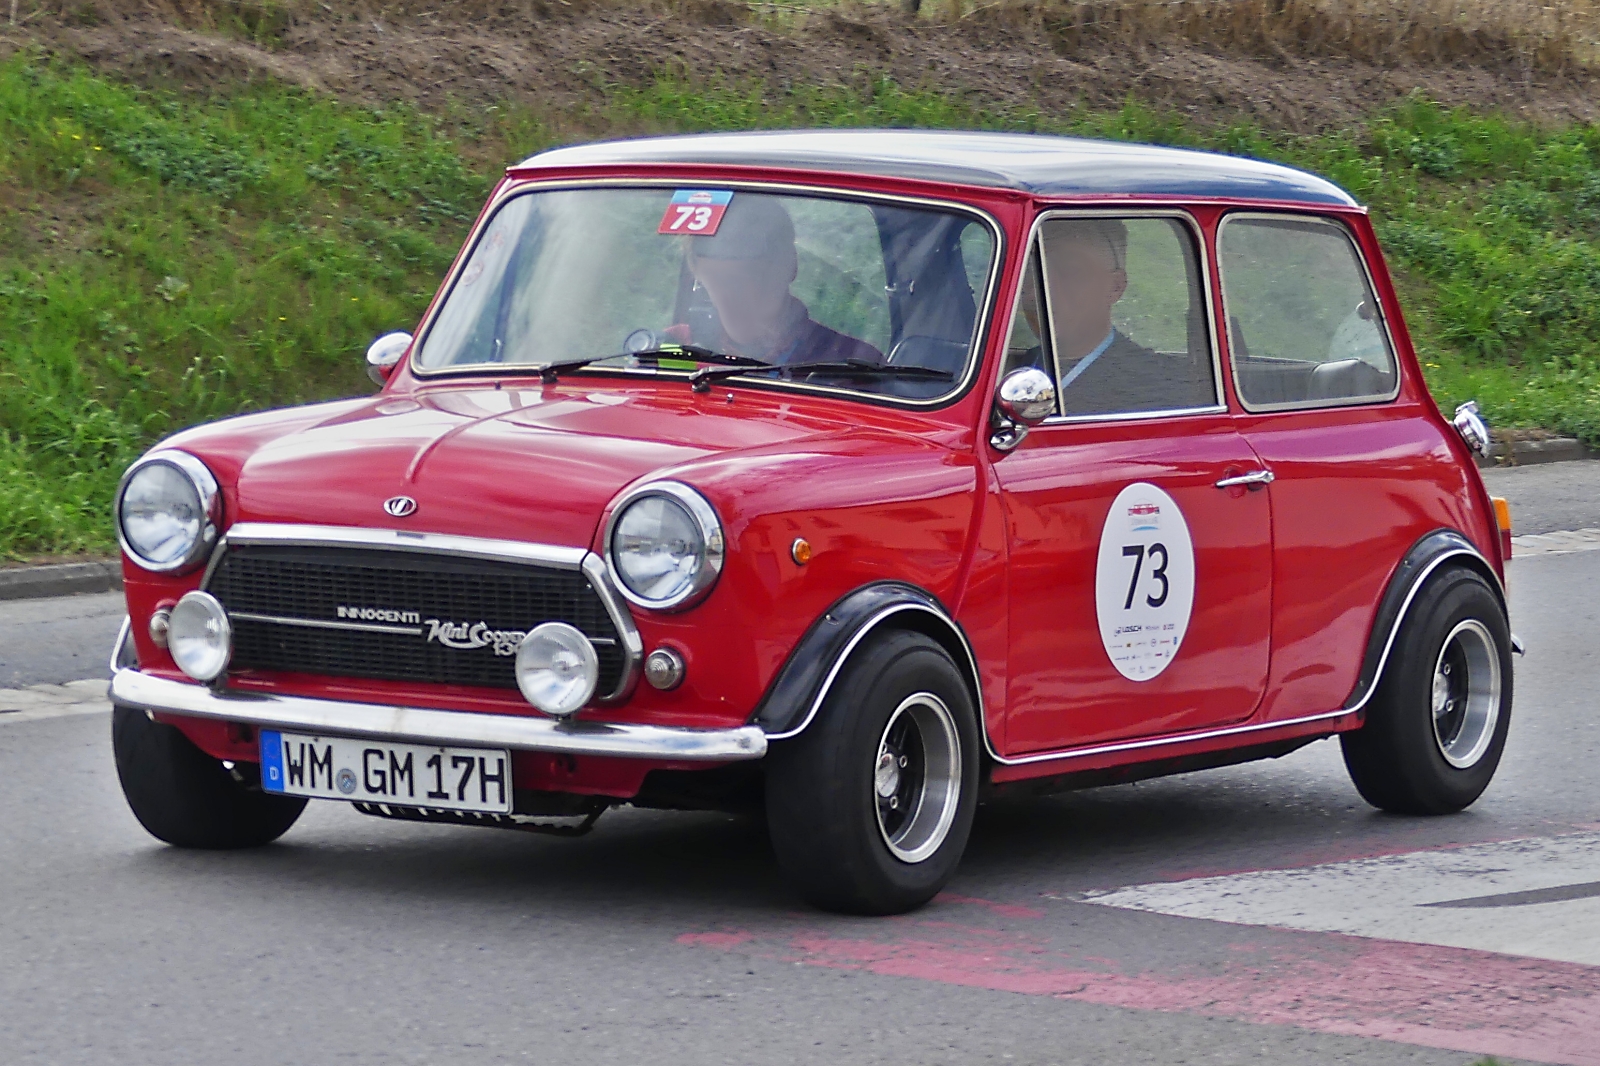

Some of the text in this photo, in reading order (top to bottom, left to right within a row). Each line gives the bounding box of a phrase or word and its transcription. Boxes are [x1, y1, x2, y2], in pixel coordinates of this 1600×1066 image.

[670, 206, 712, 230] 73
[1122, 543, 1168, 610] 73
[337, 606, 421, 624] INNOCENTI
[424, 619, 470, 647] Mini
[269, 767, 279, 780] D
[285, 741, 505, 804] WM GM 17H
